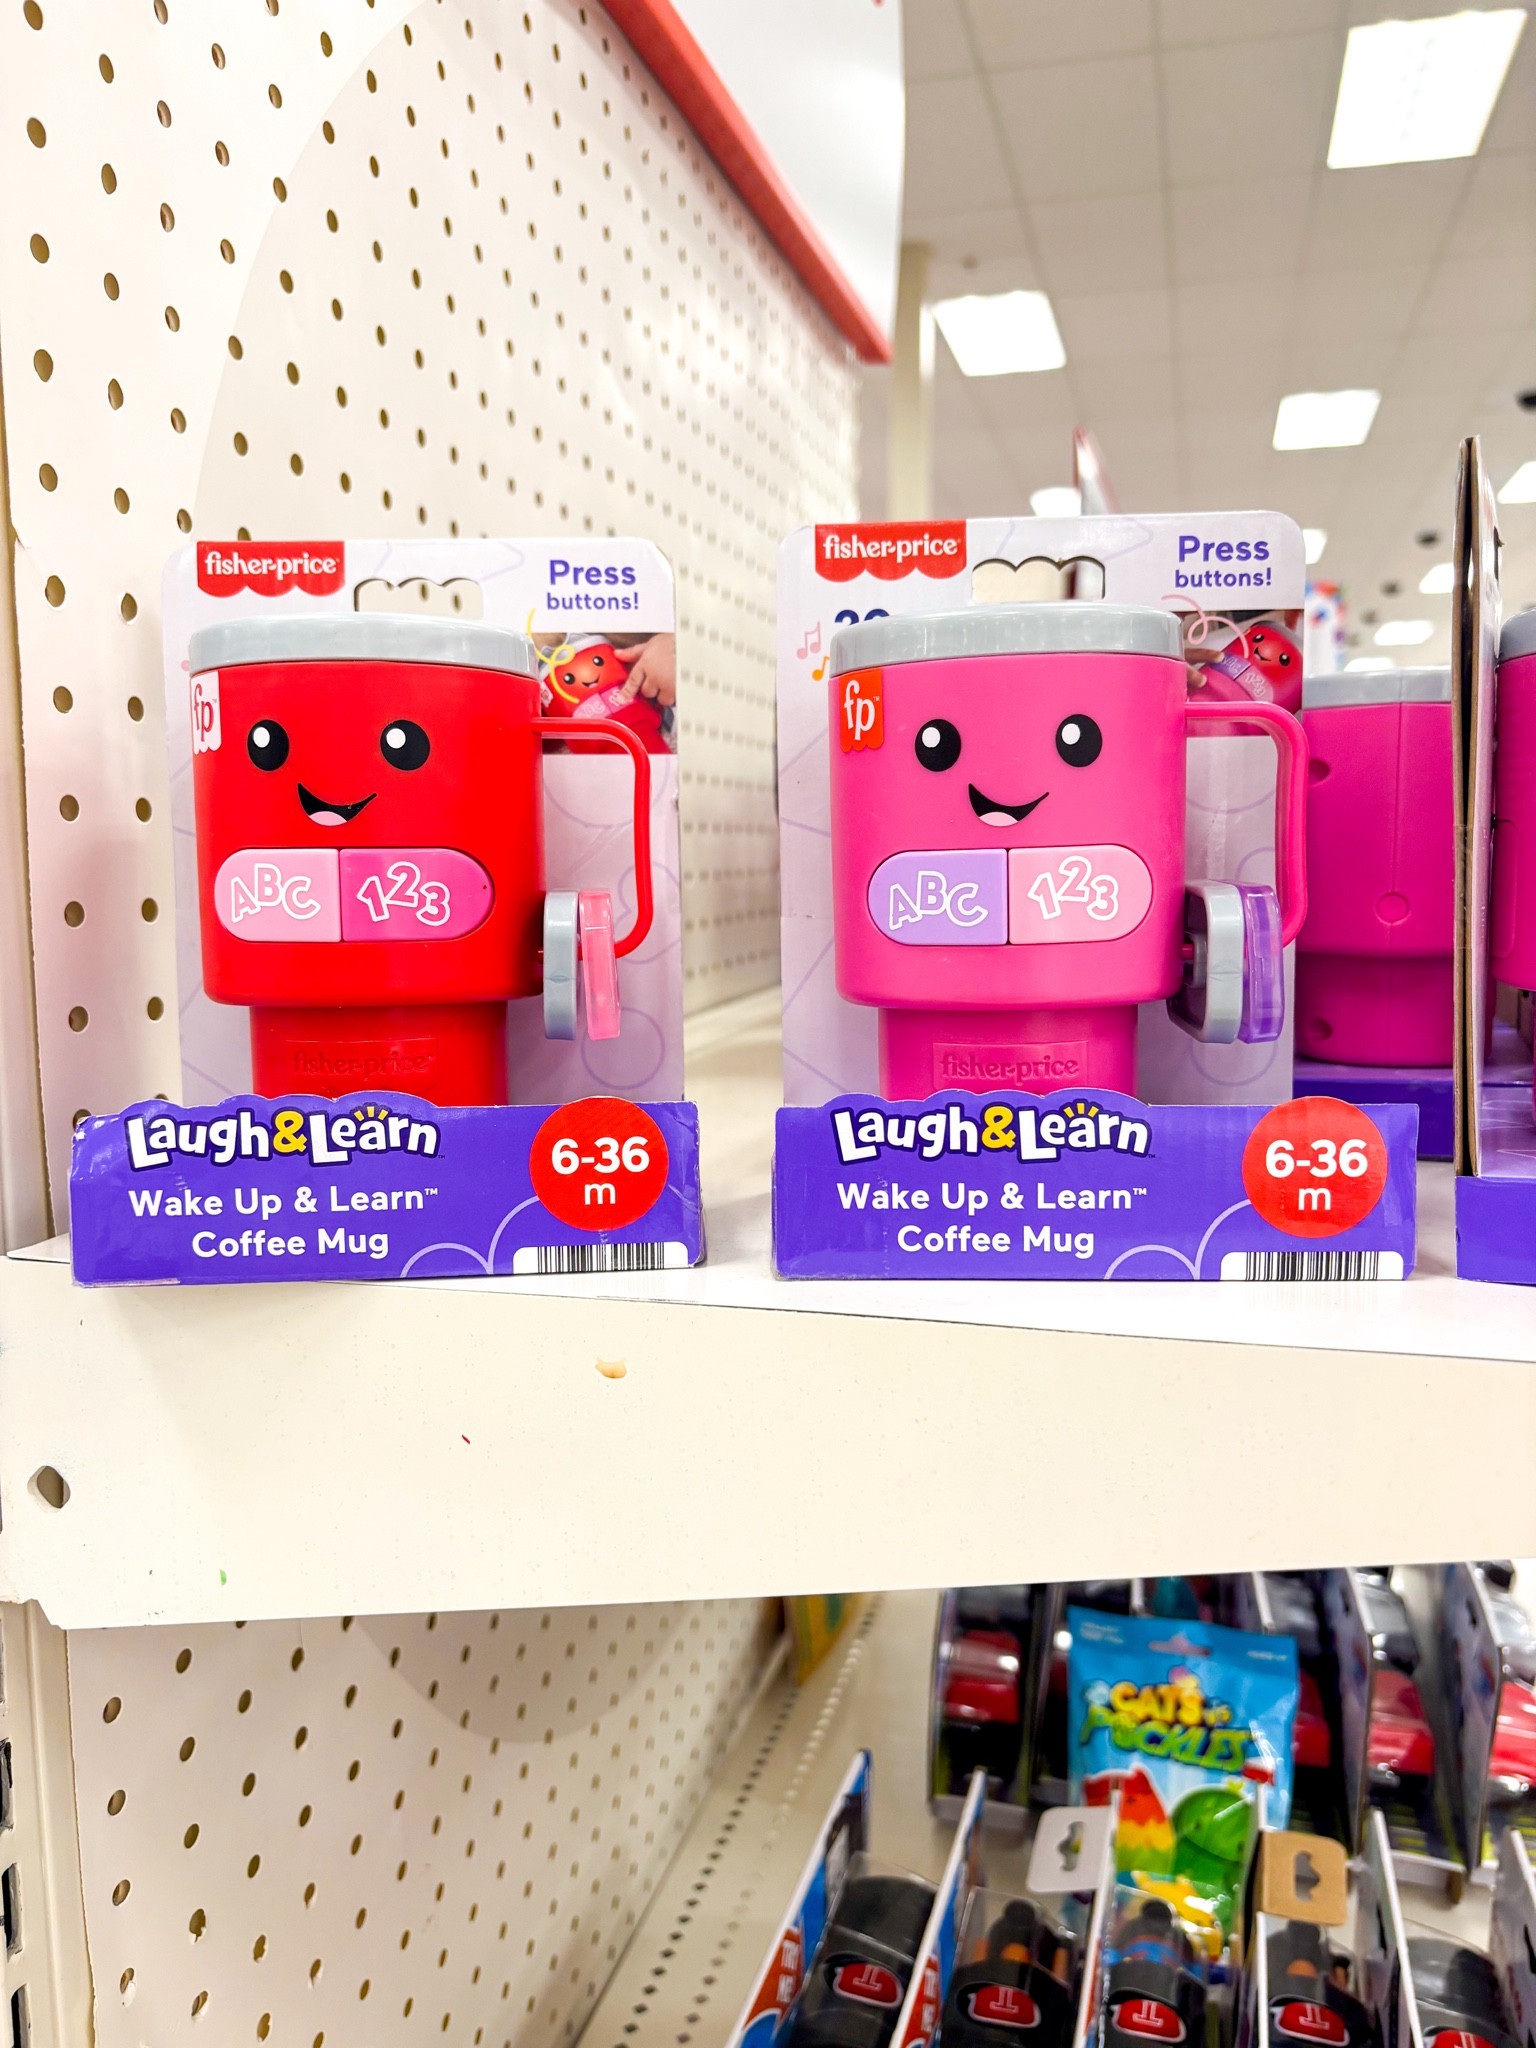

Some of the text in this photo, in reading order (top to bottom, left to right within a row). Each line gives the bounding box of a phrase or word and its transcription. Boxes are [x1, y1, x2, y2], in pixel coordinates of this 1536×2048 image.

[823, 533, 959, 563] fisher-price
[1178, 535, 1270, 563] Press
[204, 551, 337, 580] fisher-price
[549, 559, 637, 586] Press
[1174, 567, 1272, 588] buttons!
[546, 592, 639, 610] buttons!
[230, 863, 321, 923] ABC
[357, 861, 451, 926] 123
[889, 871, 988, 930] ABC
[1028, 856, 1119, 921] 123
[292, 1051, 434, 1081] fisher-price
[941, 1053, 1080, 1086] fisher-price
[552, 1136, 650, 1175] 6-36
[1266, 1139, 1368, 1178] 6-36
[129, 1188, 223, 1217] Wake
[234, 1187, 282, 1220] Up
[294, 1186, 318, 1213] &
[584, 1183, 616, 1205] m
[836, 1182, 930, 1210] Wake
[941, 1183, 989, 1216] Up
[1000, 1182, 1024, 1210] &
[1298, 1187, 1331, 1211] m
[192, 1228, 388, 1259] Coffee Mug
[897, 1225, 1094, 1259] Coffee Mug
